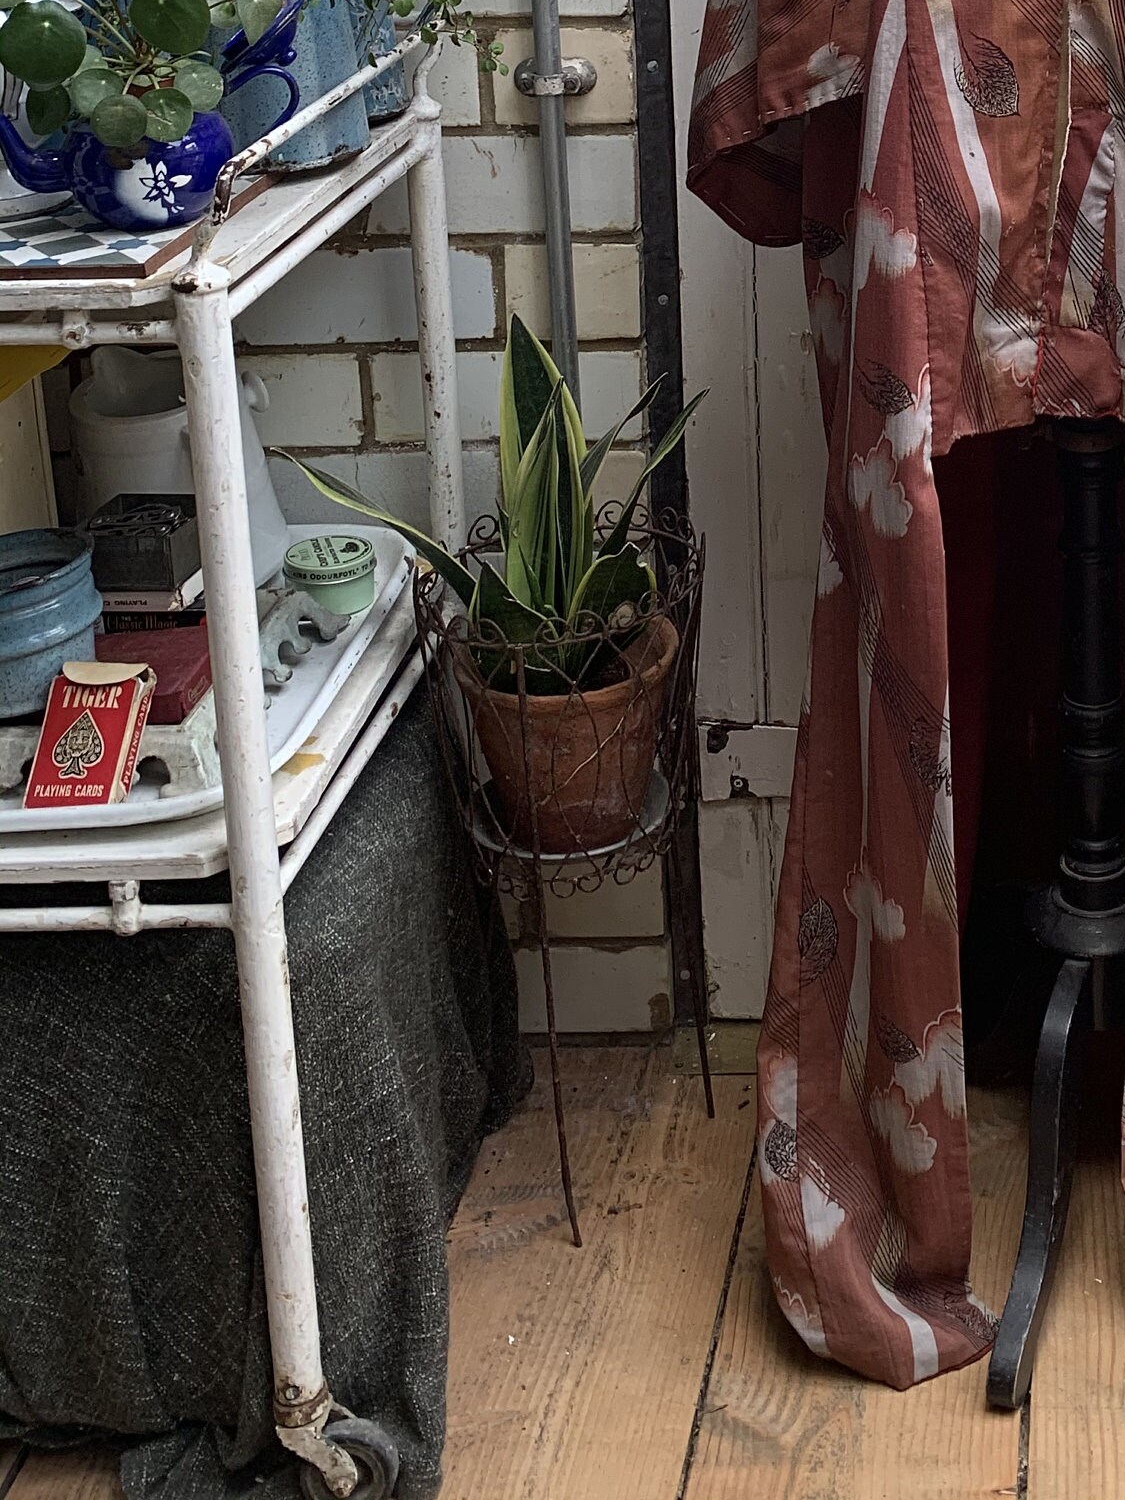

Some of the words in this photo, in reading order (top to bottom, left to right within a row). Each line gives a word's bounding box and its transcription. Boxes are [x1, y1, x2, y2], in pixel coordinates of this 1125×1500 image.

[62, 685, 123, 709] TIGER
[123, 731, 140, 785] PLAYING
[34, 784, 72, 797] PLAYING
[74, 784, 105, 797] CARDS
